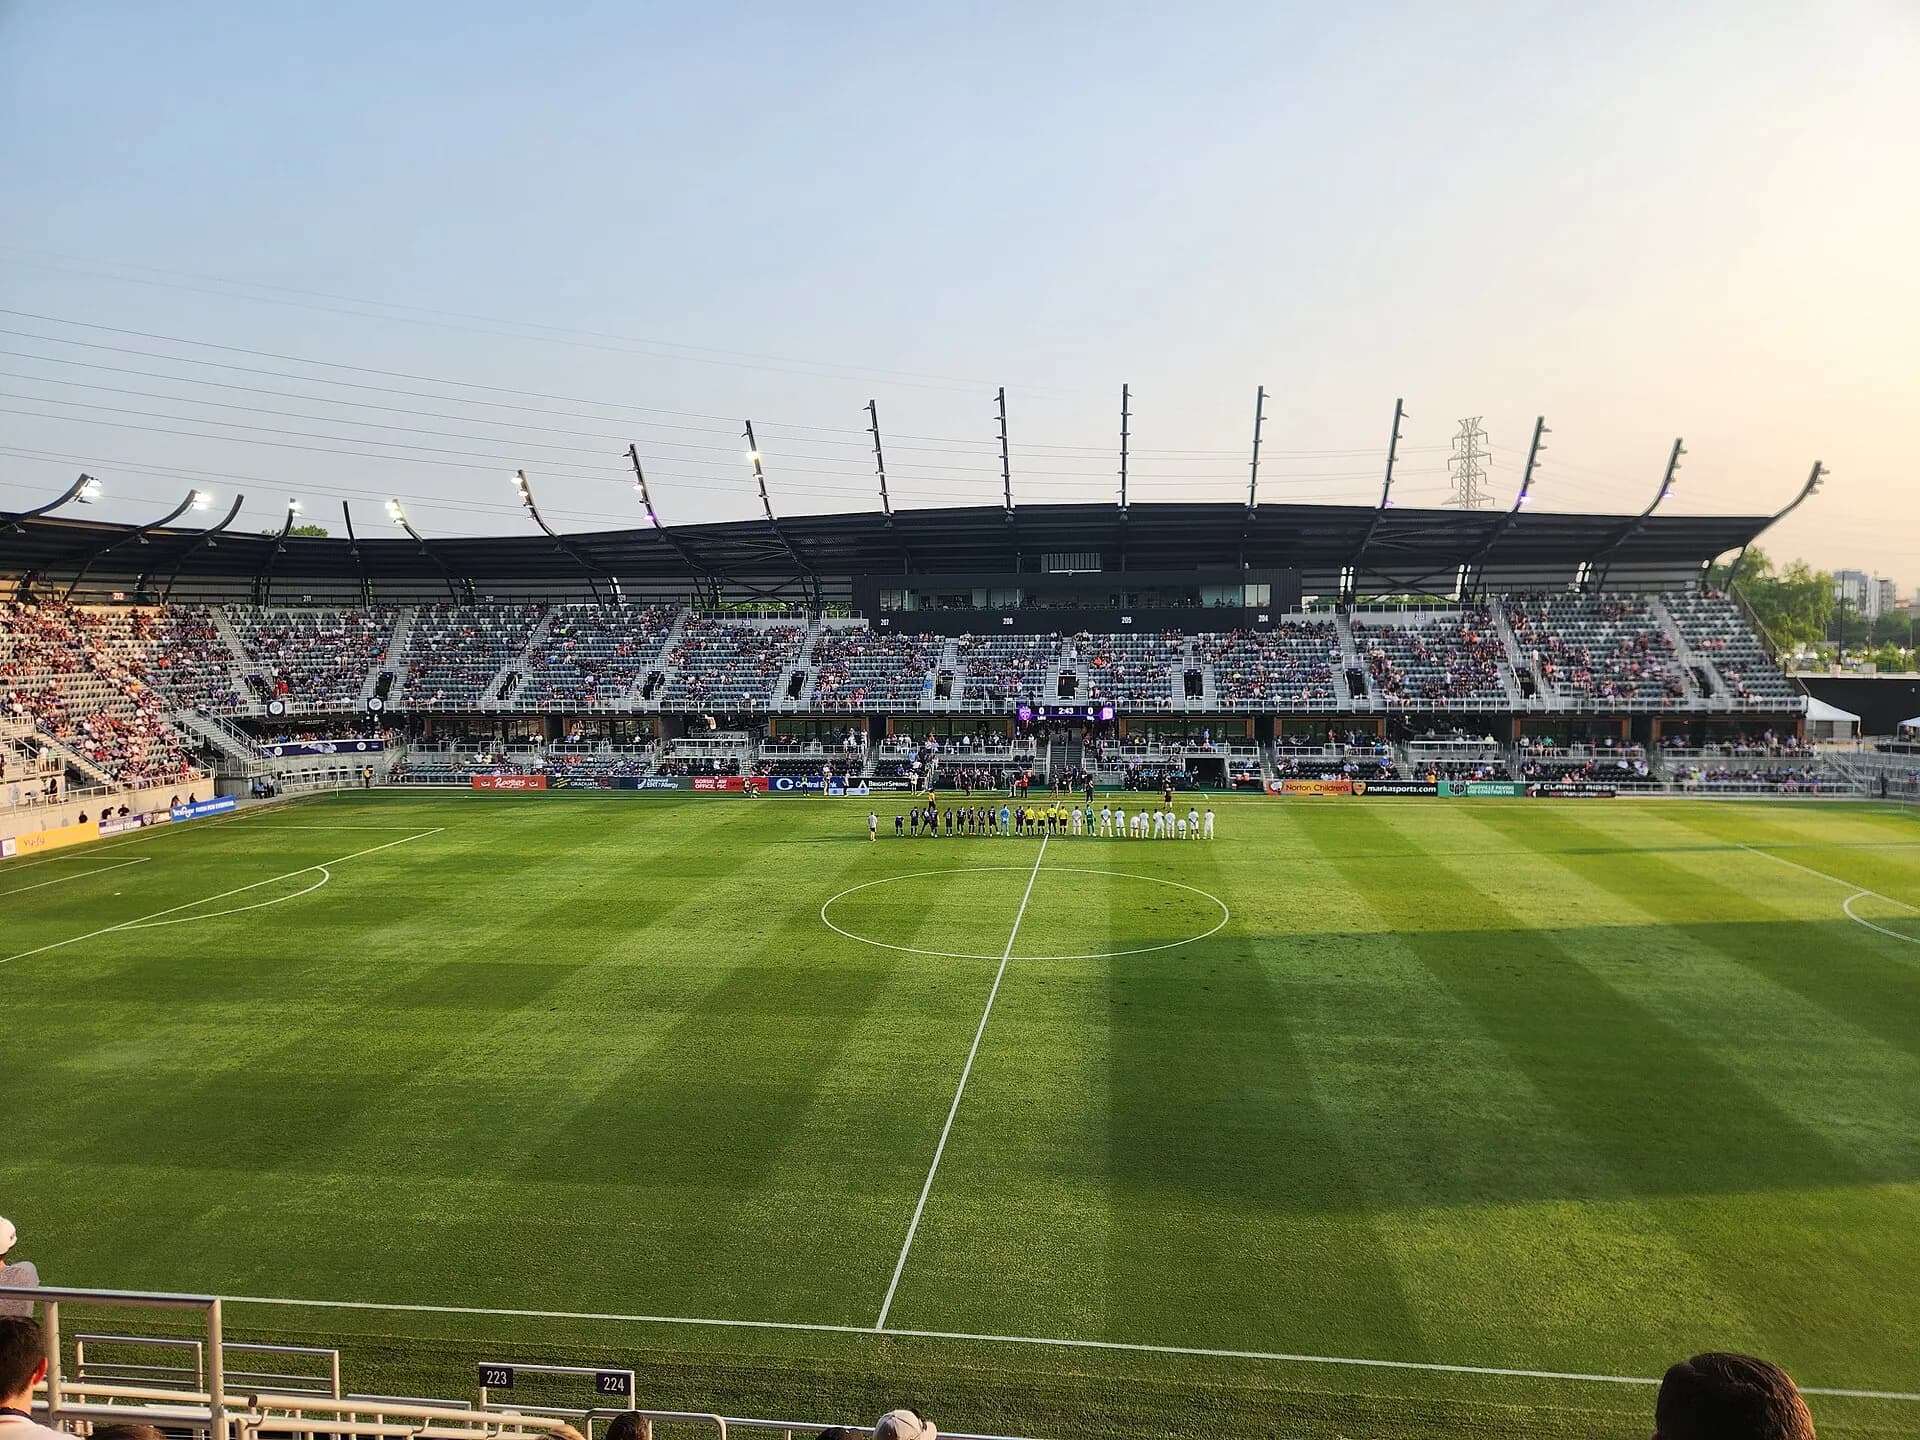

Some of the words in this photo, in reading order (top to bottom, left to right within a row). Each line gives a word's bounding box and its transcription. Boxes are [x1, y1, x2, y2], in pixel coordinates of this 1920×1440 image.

[1121, 616, 1132, 624] 205
[1038, 706, 1044, 715] 0
[1088, 706, 1094, 715] 0
[1286, 784, 1311, 792] Norton
[1314, 784, 1350, 792] Children's
[1367, 784, 1436, 794] markasports.com
[486, 1370, 508, 1385] 223
[604, 1376, 625, 1392] 224
